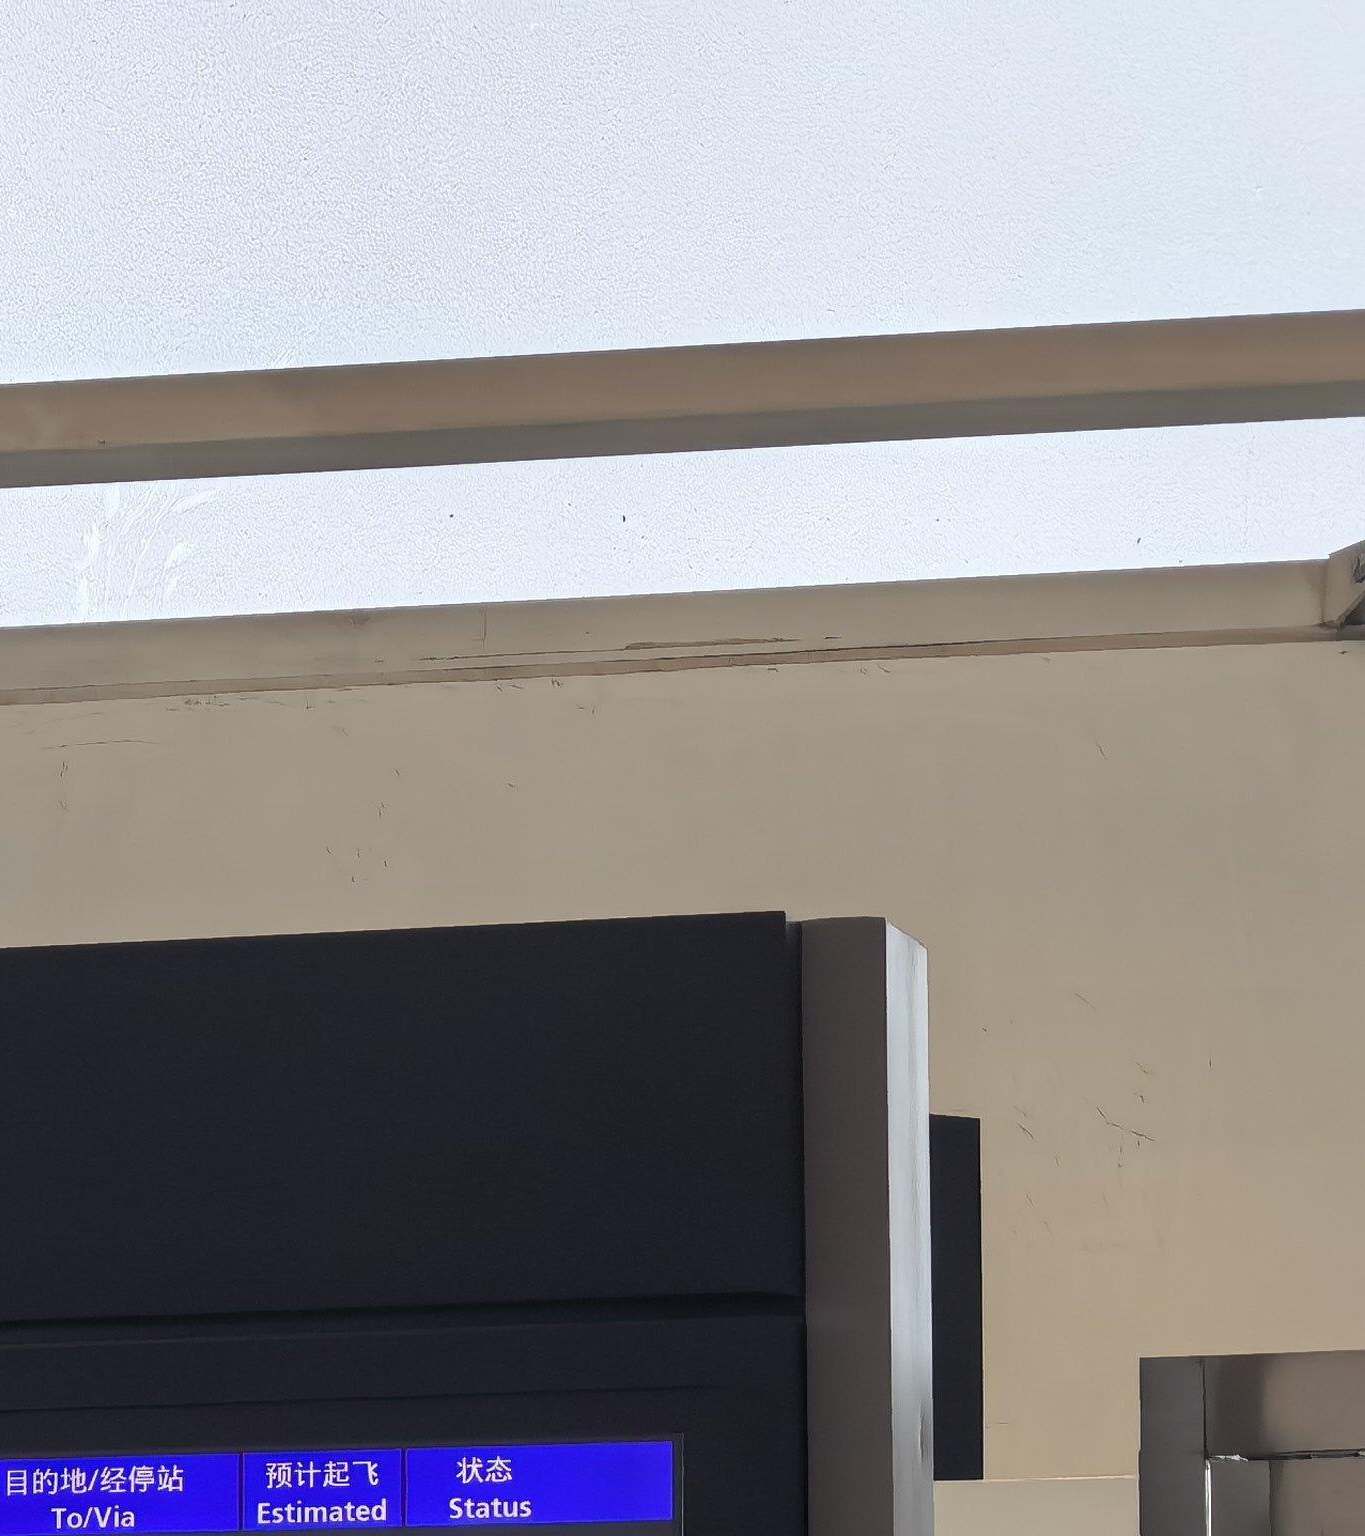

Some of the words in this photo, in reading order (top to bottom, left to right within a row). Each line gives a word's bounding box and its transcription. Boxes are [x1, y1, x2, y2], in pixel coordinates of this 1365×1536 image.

[5, 1464, 184, 1495] 目的地/经停站
[265, 1459, 380, 1490] 预计起飞
[456, 1455, 513, 1486] 状态
[51, 1503, 136, 1530] To/Via
[256, 1497, 387, 1526] Estimated
[448, 1492, 532, 1521] Status
